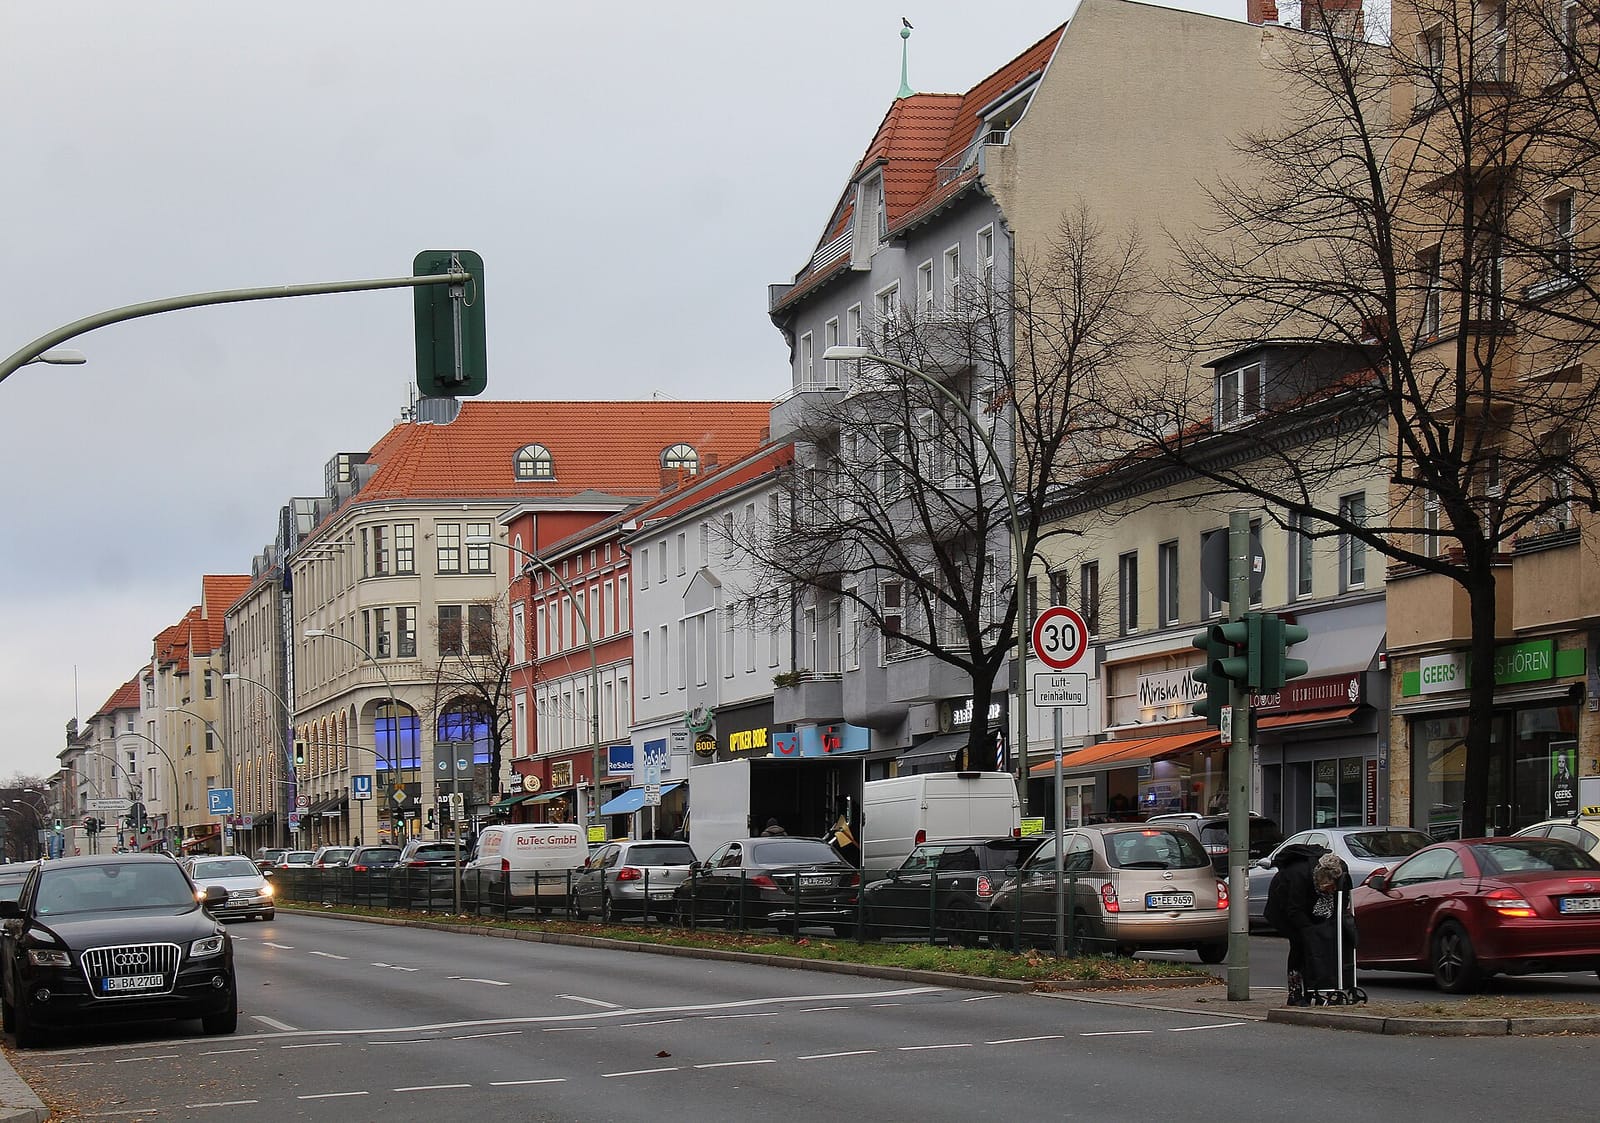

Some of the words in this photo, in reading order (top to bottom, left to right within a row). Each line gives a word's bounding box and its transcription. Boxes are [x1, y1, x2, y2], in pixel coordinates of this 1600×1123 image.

[1044, 624, 1076, 651] 30
[1507, 650, 1549, 673] HÖREN
[1423, 664, 1455, 684] GEERS
[1051, 677, 1071, 688] Luft-
[1040, 688, 1082, 703] reinhaltung
[1140, 678, 1178, 706] Mirisha
[1292, 683, 1344, 702] KOSMETIKSTUDIO
[695, 740, 717, 751] BODE
[729, 730, 752, 752] OPTIKER
[752, 728, 768, 748] BODE
[608, 761, 634, 769] ReSales
[644, 747, 667, 769] ReSales
[357, 777, 369, 792] U
[211, 795, 220, 809] P
[517, 836, 545, 846] RuTec
[547, 835, 577, 845] GmbH
[1152, 897, 1157, 905] B
[1162, 897, 1172, 905] EE
[1174, 896, 1192, 905] 9659
[109, 979, 115, 989] B
[122, 978, 135, 988] BA
[137, 976, 162, 987] 2700
